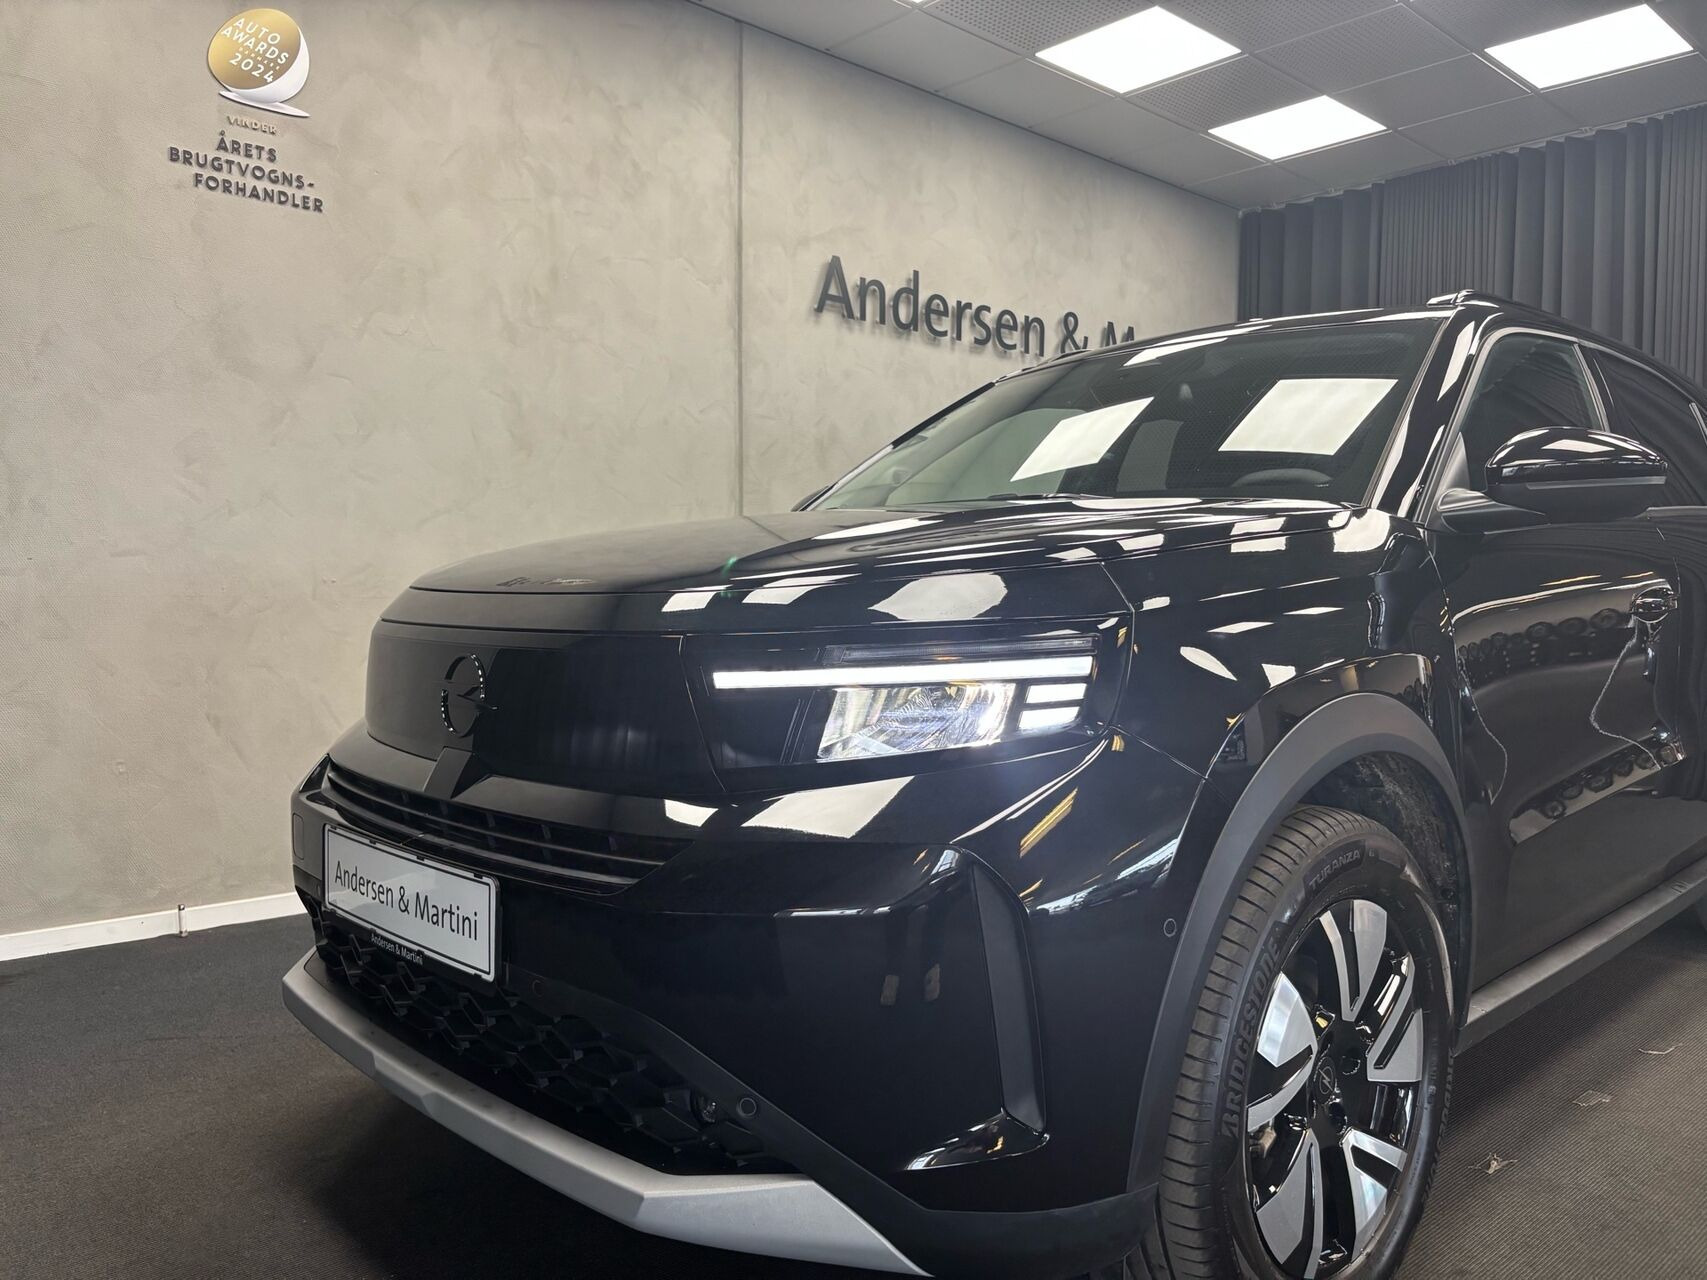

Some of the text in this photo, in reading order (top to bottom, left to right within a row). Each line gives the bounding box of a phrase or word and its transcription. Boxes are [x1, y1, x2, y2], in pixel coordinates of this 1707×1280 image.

[221, 26, 289, 65] AWARDS
[229, 17, 281, 45] AUTO
[229, 52, 274, 83] 2024
[226, 115, 278, 135] VINDER
[216, 130, 278, 163] ÅRETS
[168, 146, 316, 190] BRUGTVOGNS-
[193, 172, 324, 213] FORHANDLER
[813, 254, 1089, 358] Andersen &
[1308, 849, 1361, 890] TURANZA
[335, 861, 478, 941] Andersen & Martini
[371, 934, 396, 953] Andersen
[402, 947, 424, 966] Martini
[1221, 937, 1281, 1138] BRIDGESTONE
